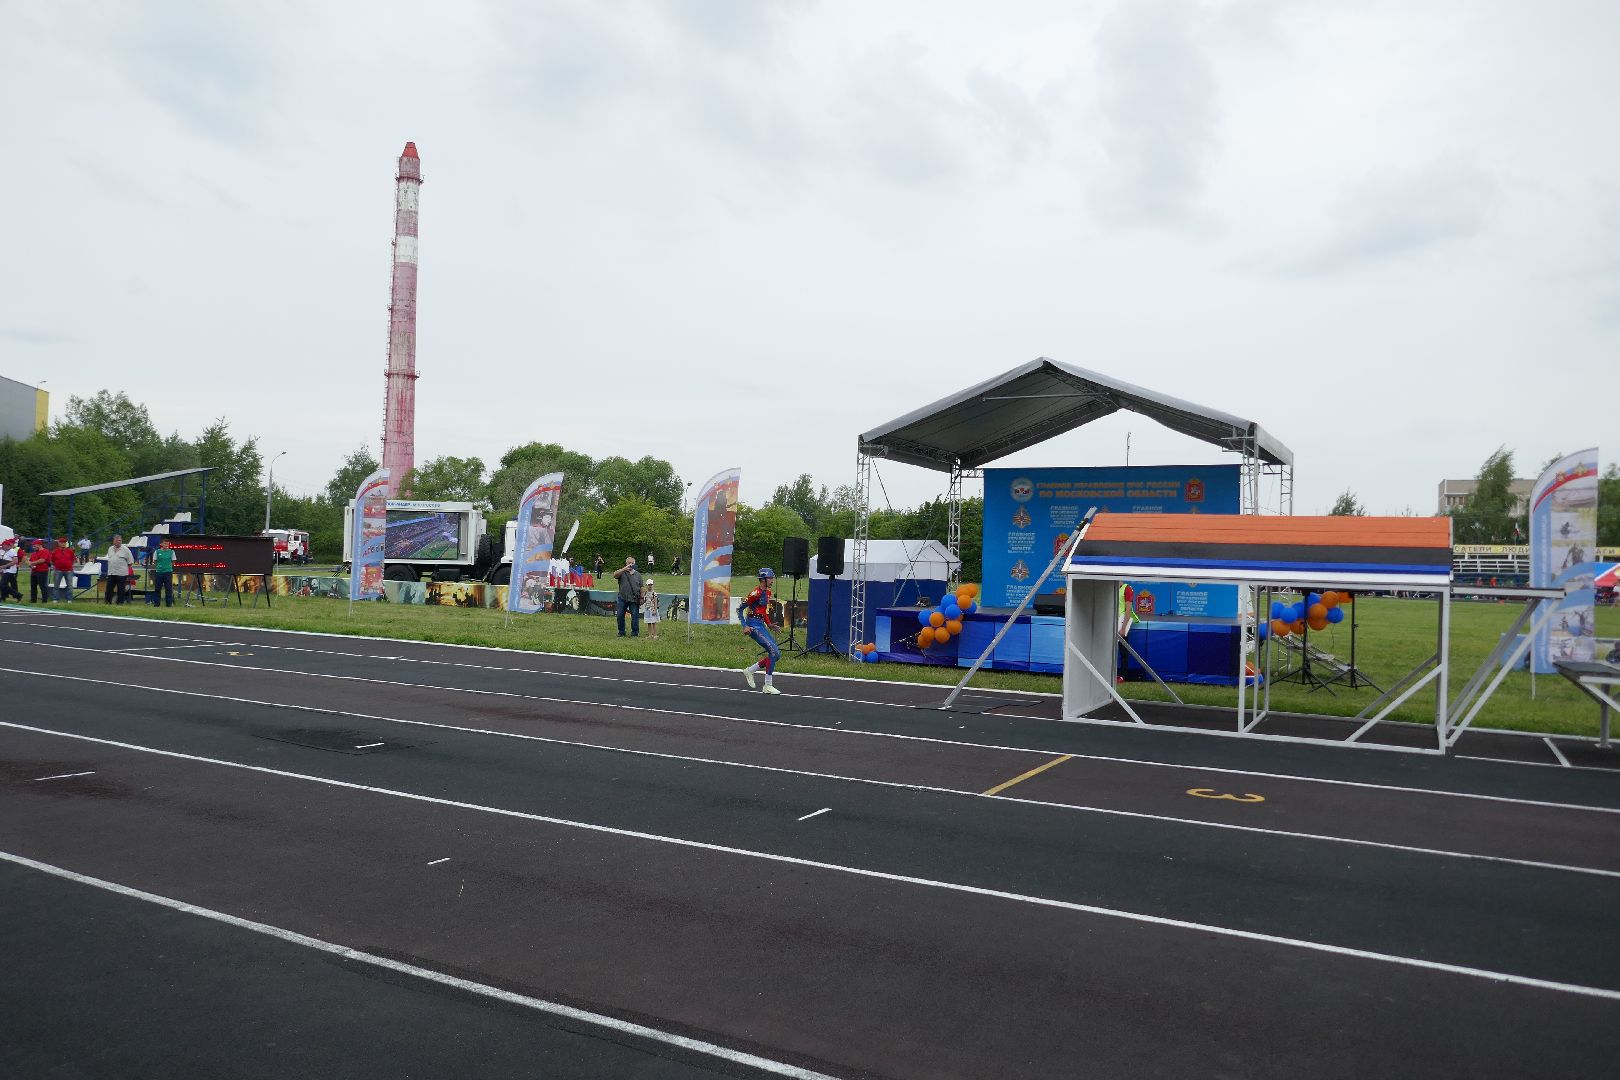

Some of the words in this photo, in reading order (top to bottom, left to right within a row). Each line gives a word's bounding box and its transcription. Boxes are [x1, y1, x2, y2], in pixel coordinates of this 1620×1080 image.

[1039, 490, 1053, 498] ПО
[1055, 489, 1124, 498] МОСКОВСКОЙ
[1126, 490, 1177, 498] ОБЛАСТИ
[1185, 788, 1266, 803] 3
